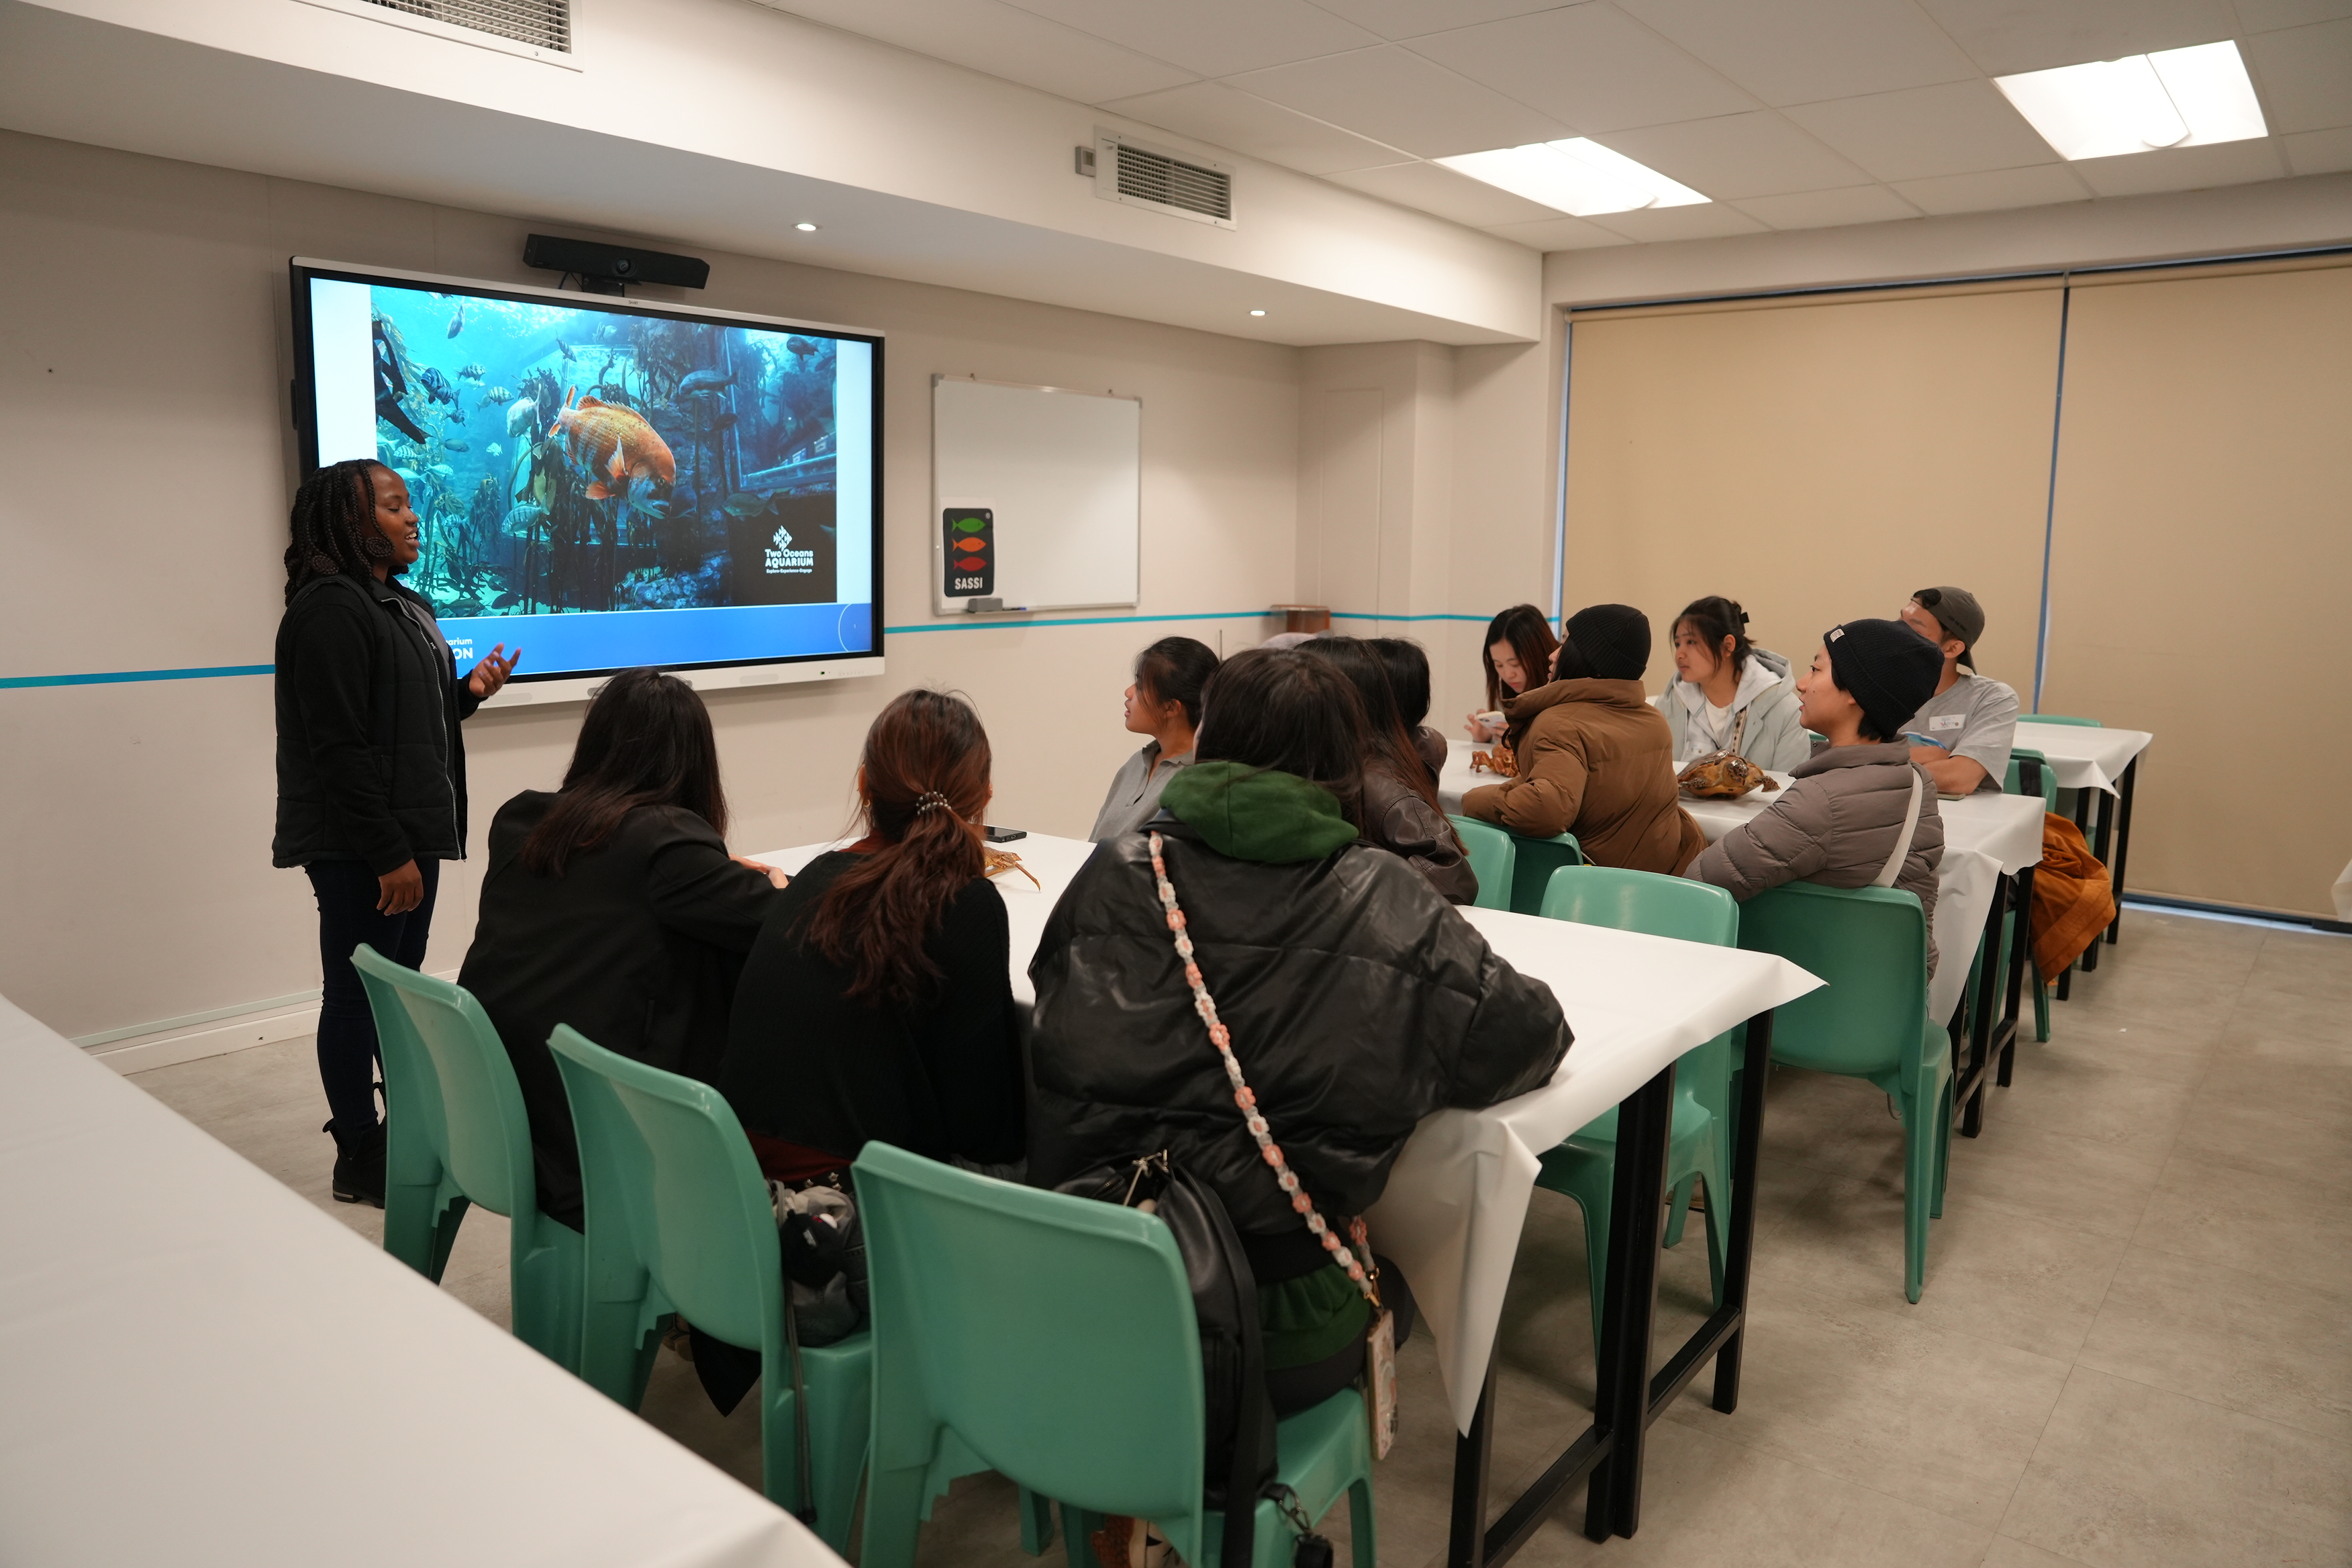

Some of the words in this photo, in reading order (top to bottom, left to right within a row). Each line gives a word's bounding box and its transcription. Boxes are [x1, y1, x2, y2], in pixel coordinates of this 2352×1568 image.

[765, 548, 782, 558] Two
[783, 548, 814, 558] Oceans
[765, 557, 814, 569] AQUARIUM
[954, 577, 983, 590] SASSI
